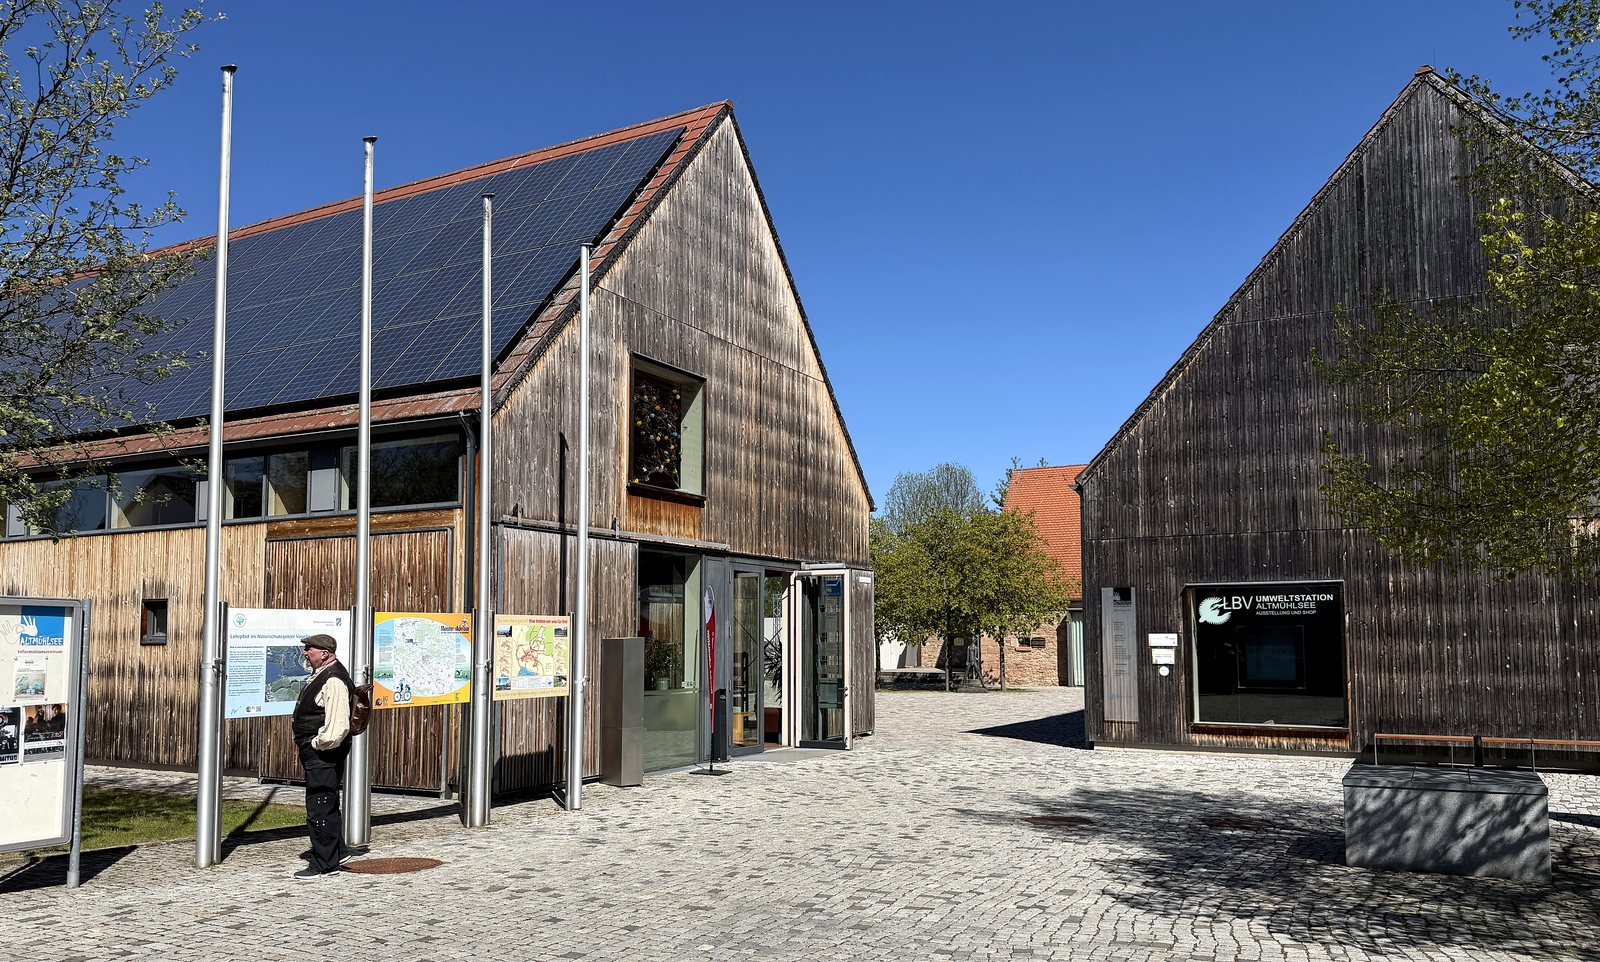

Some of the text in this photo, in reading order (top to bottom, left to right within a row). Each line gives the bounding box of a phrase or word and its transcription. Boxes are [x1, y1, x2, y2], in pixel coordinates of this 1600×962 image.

[1223, 594, 1334, 610] LBV UMWELTSTATION
[1256, 602, 1316, 610] ALTMÜHLSEE
[20, 636, 64, 646] ALTMÜHLSEE
